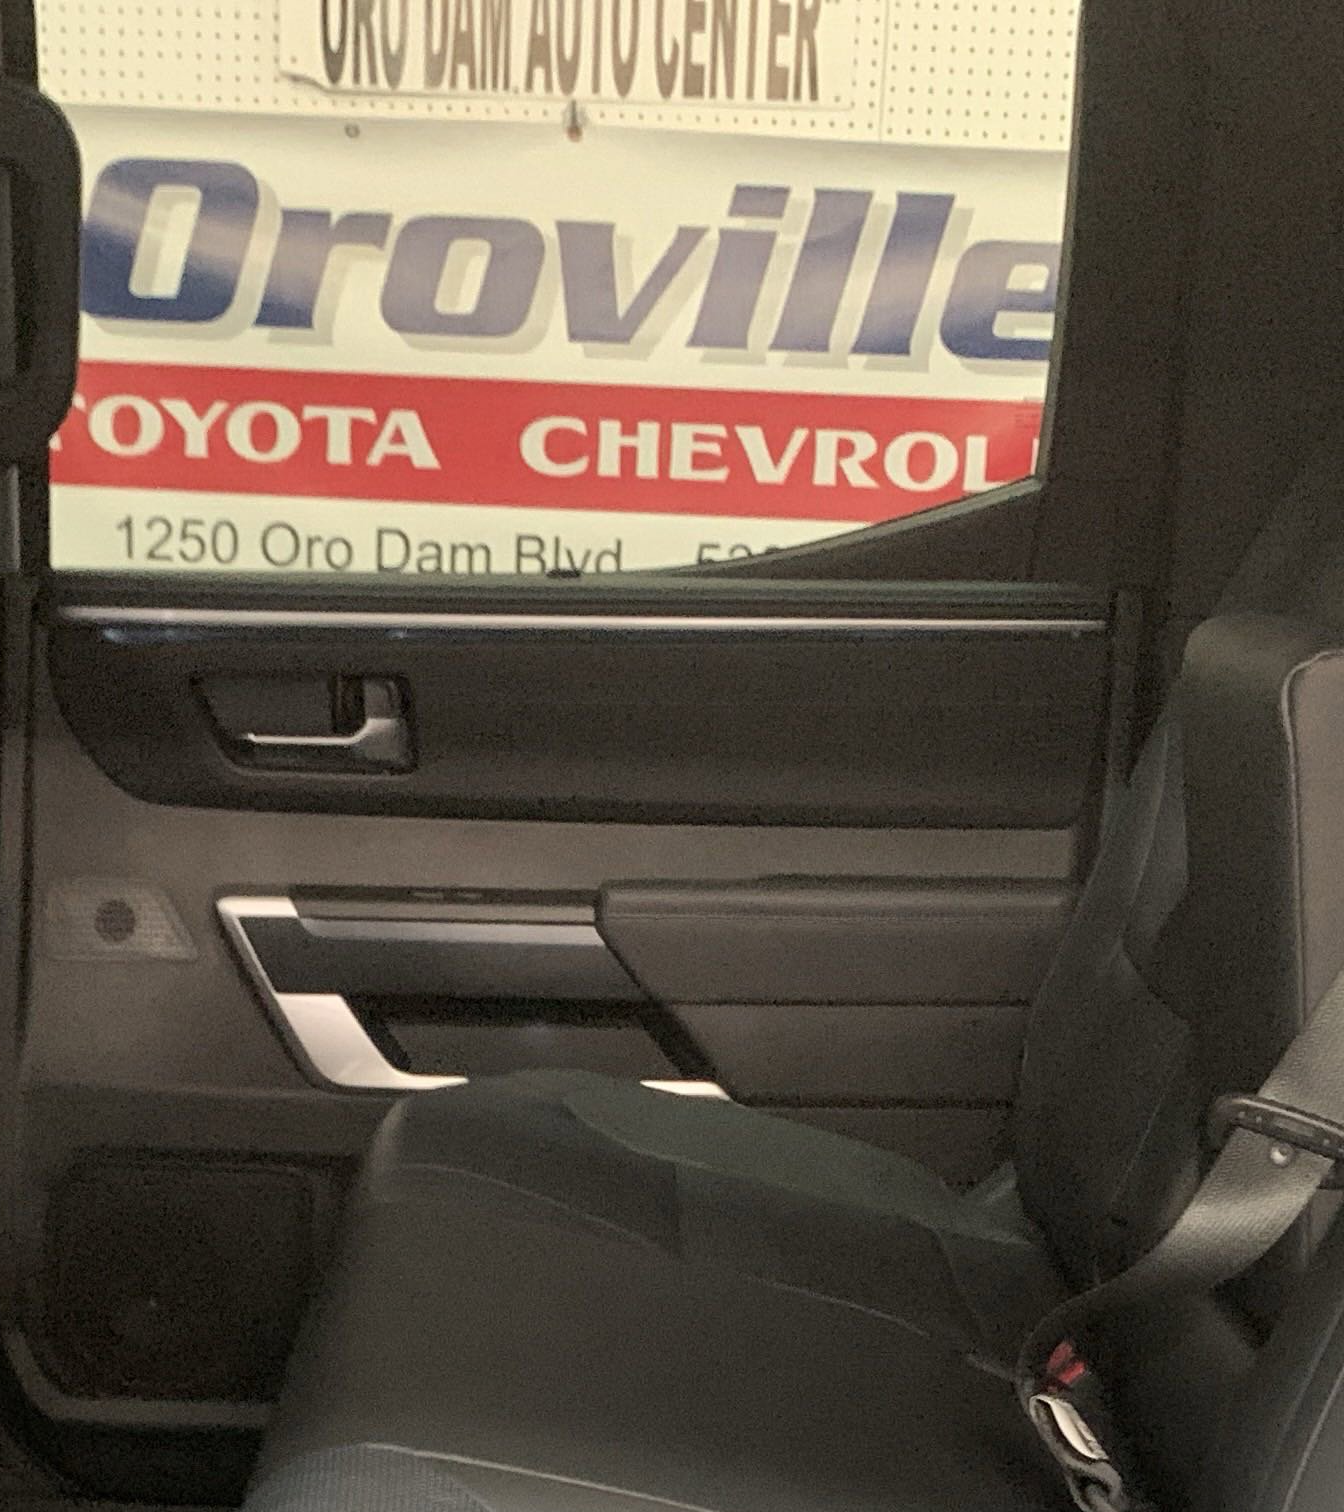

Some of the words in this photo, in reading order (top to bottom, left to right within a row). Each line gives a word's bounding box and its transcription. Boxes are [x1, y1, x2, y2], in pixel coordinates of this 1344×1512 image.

[424, 0, 511, 91] DAM
[80, 157, 1061, 361] Oroville
[518, 415, 1040, 493] CHEVROL
[116, 515, 239, 564] 1250
[260, 520, 354, 571] Oro
[376, 527, 492, 574] Dam
[516, 533, 623, 575] Blvd
